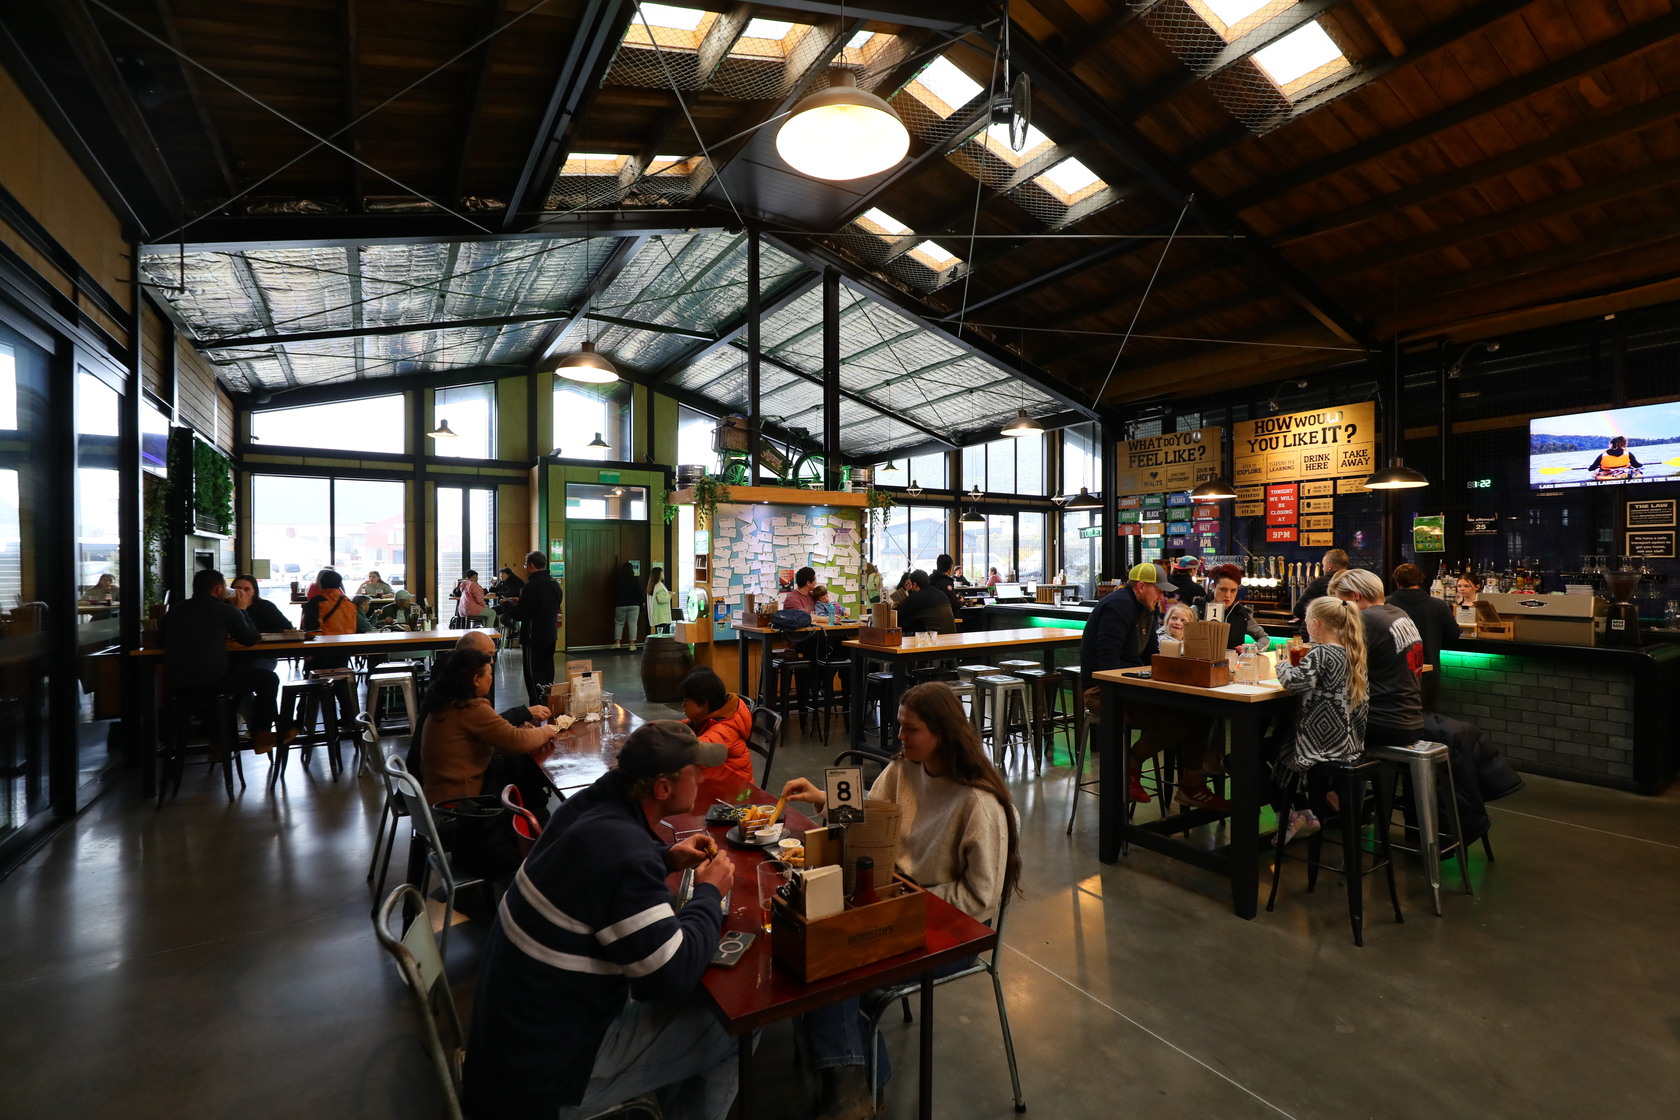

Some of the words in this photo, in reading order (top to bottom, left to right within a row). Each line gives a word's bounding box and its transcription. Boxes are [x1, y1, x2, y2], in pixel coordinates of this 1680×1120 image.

[1254, 416, 1293, 434] HOW
[1294, 410, 1344, 427] WOULD
[1128, 438, 1162, 452] WHAT
[1164, 437, 1174, 447] DO
[1174, 432, 1201, 446] YOU
[1247, 436, 1279, 452] YOU
[1283, 431, 1318, 448] LIKE
[1129, 453, 1162, 468] FEEL
[1164, 446, 1206, 464] LIKE?
[1304, 454, 1330, 463] DRINK
[1343, 449, 1368, 458] TAKE
[1306, 462, 1328, 471] HERE
[1340, 457, 1371, 468] AWAY
[1200, 539, 1212, 547] APA
[1213, 608, 1216, 617] 1
[837, 781, 852, 802] 8
